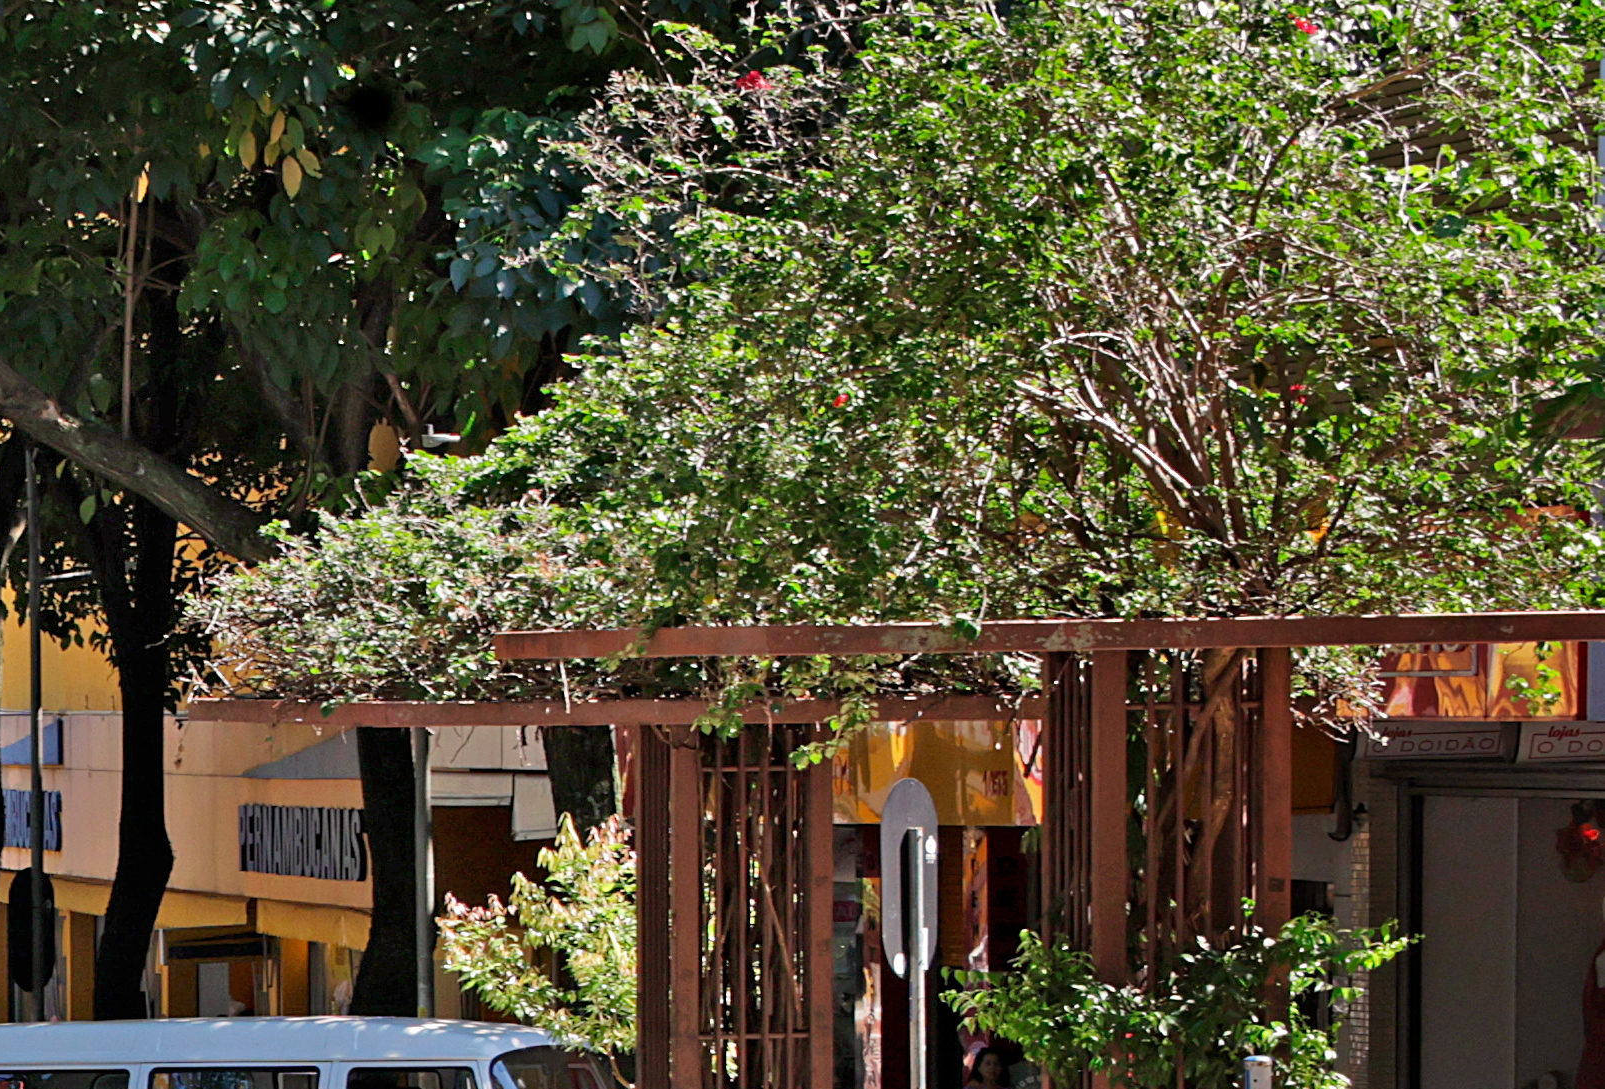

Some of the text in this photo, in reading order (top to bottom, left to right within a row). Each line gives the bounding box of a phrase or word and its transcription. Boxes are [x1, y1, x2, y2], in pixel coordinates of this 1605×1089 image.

[1400, 737, 1495, 752] DOIDÃO
[1537, 741, 1554, 754] O
[239, 803, 364, 881] PERNAMBUCANAS
